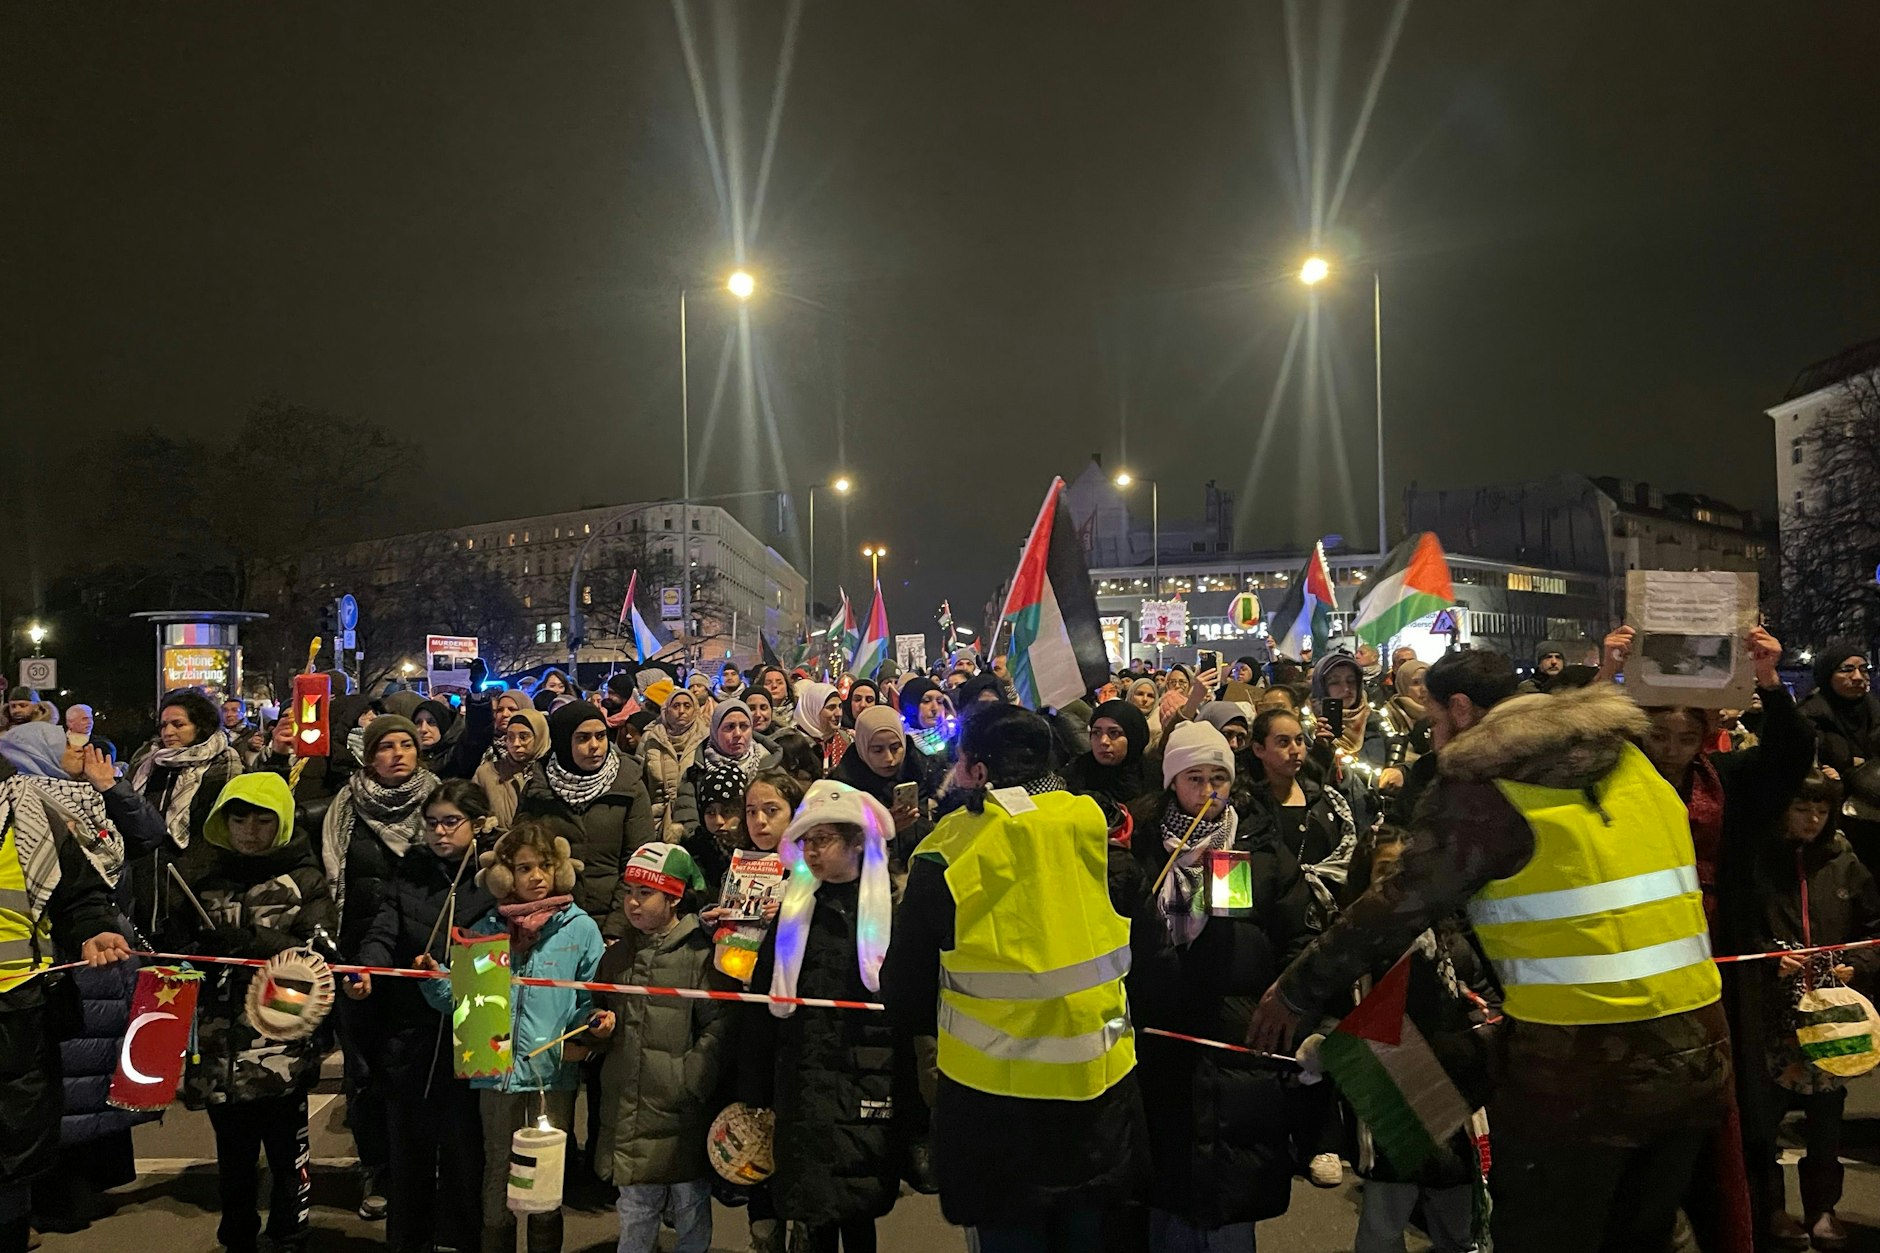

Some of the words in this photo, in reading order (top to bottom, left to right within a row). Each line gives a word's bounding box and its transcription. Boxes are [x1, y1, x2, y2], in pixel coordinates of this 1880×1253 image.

[431, 639, 474, 648] MURDERED
[176, 654, 214, 667] Schöne
[32, 666, 45, 676] 30
